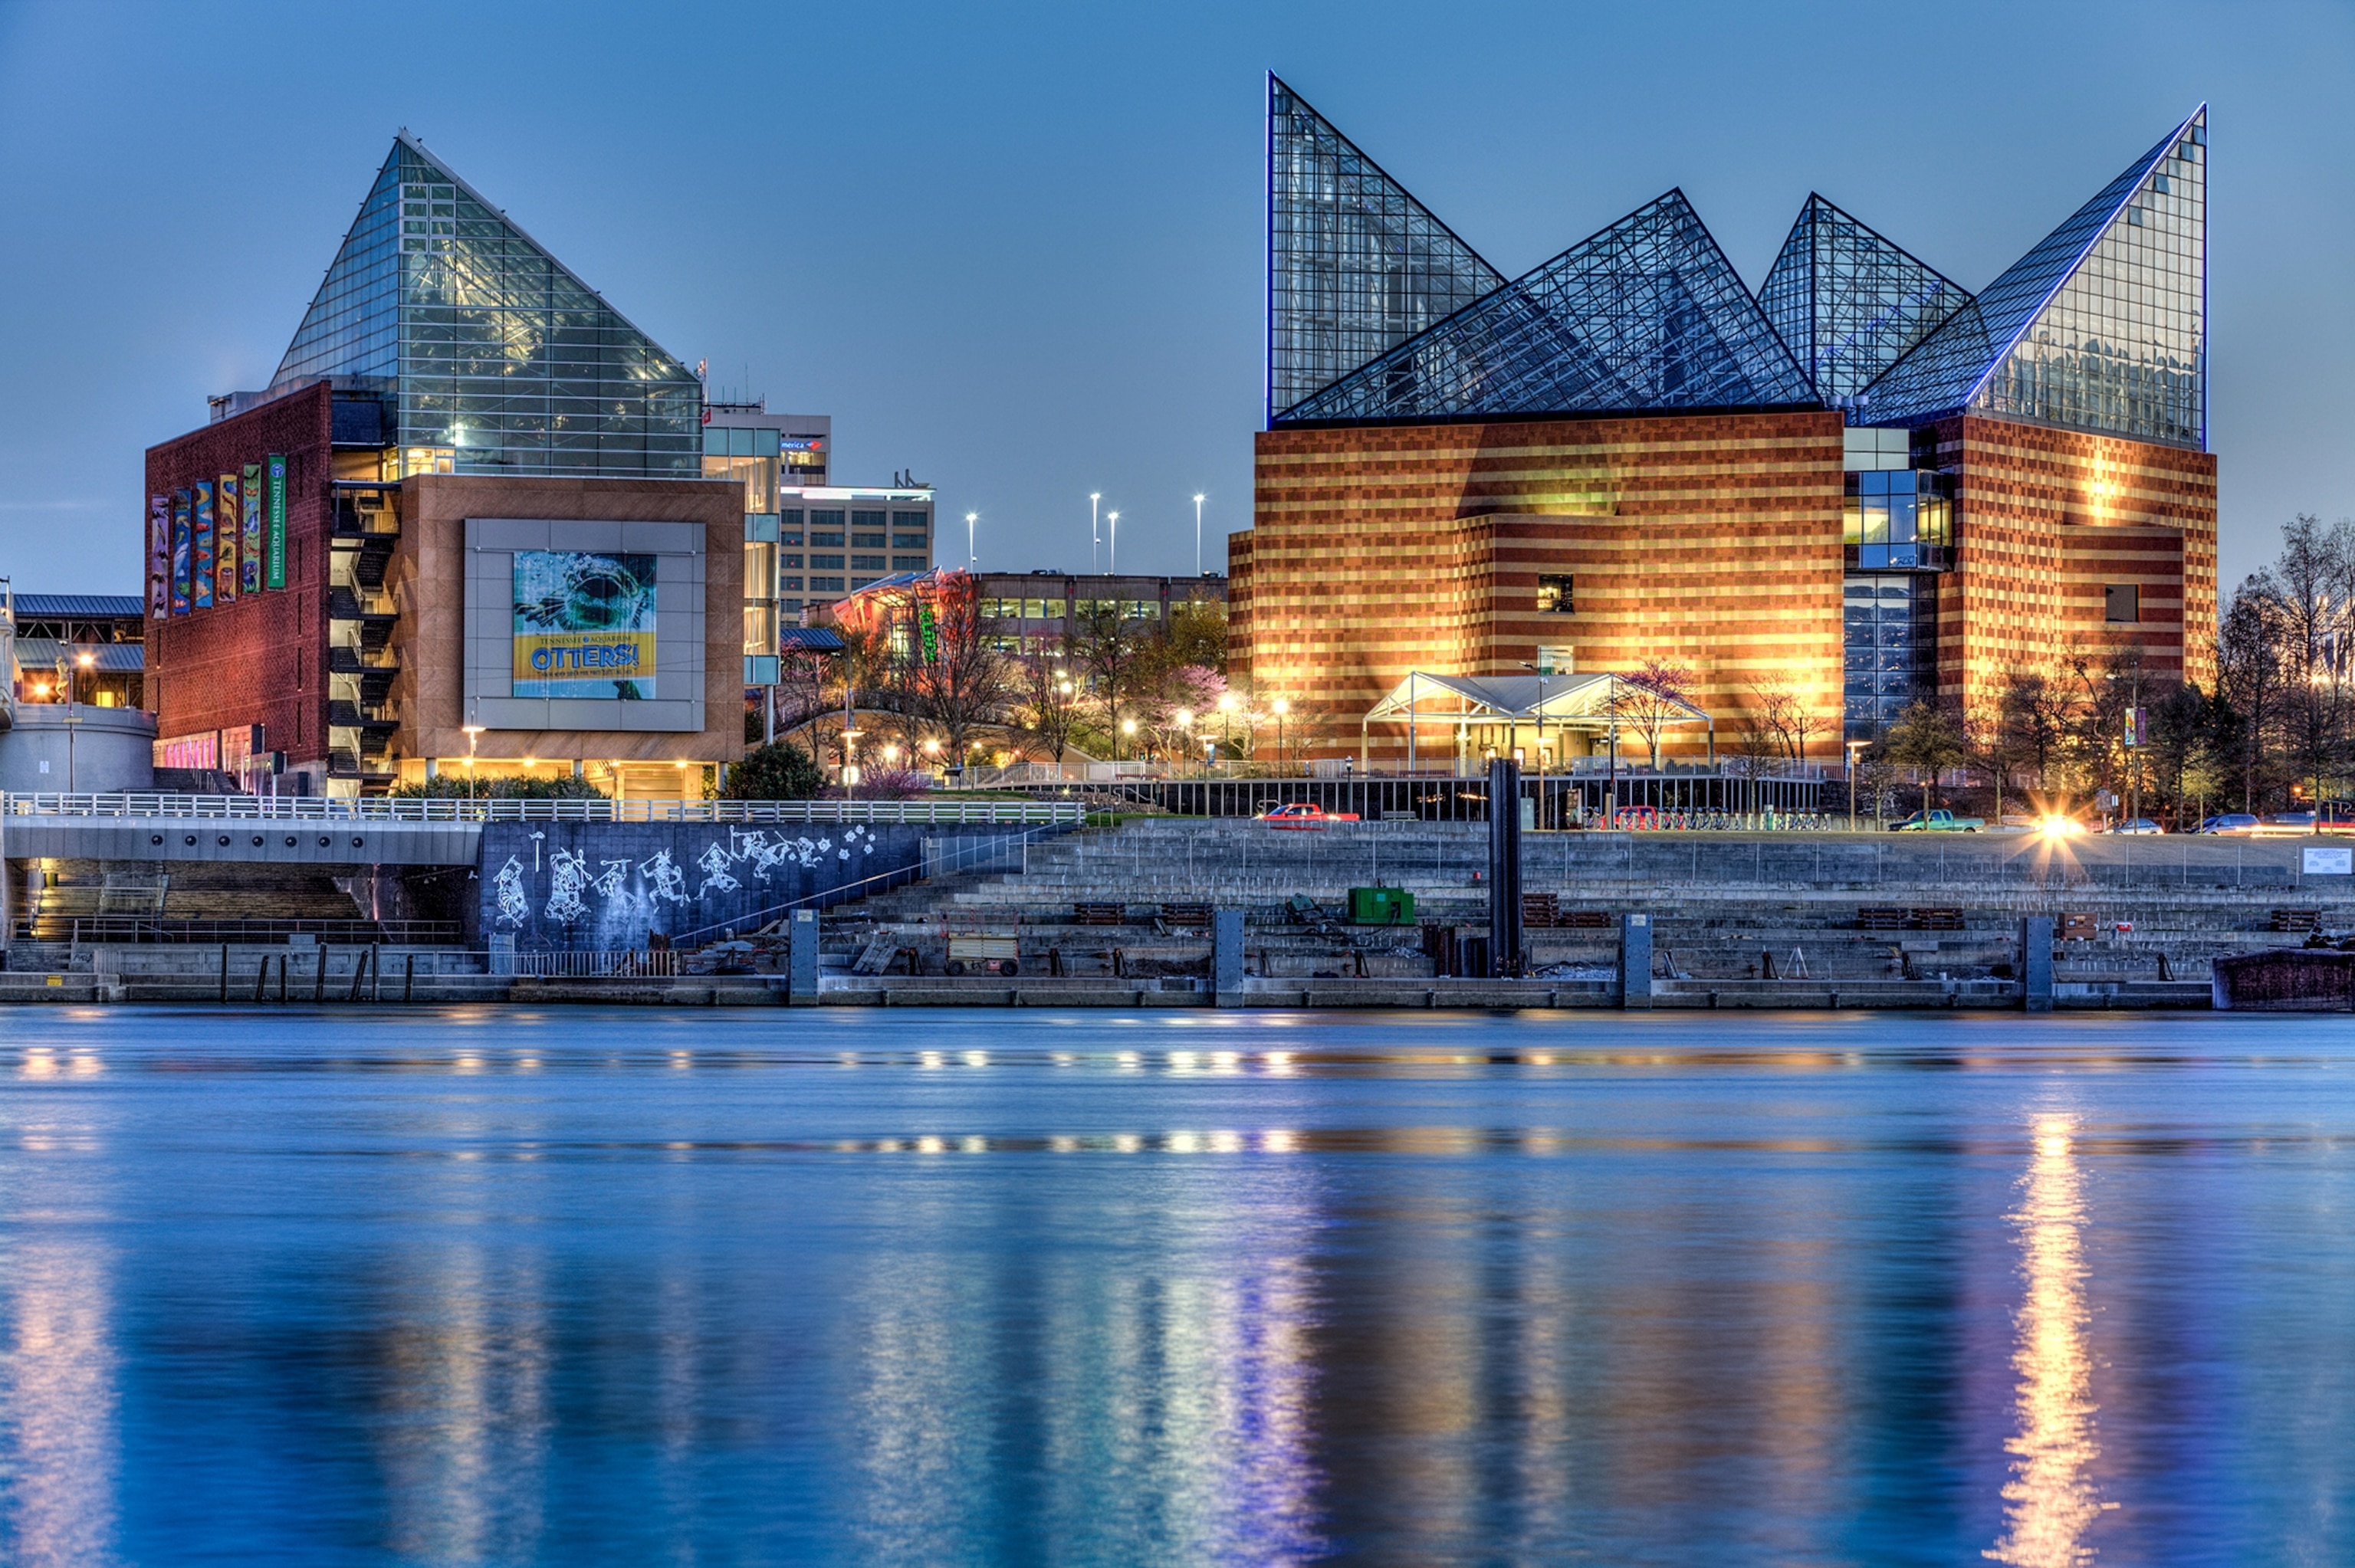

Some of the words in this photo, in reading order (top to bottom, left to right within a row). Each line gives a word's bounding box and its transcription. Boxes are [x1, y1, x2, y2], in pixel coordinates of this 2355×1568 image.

[781, 441, 804, 449] merica
[273, 481, 281, 529] TENNESSEE
[272, 530, 281, 579] AQUARIUM
[531, 643, 639, 670] OTTERS!
